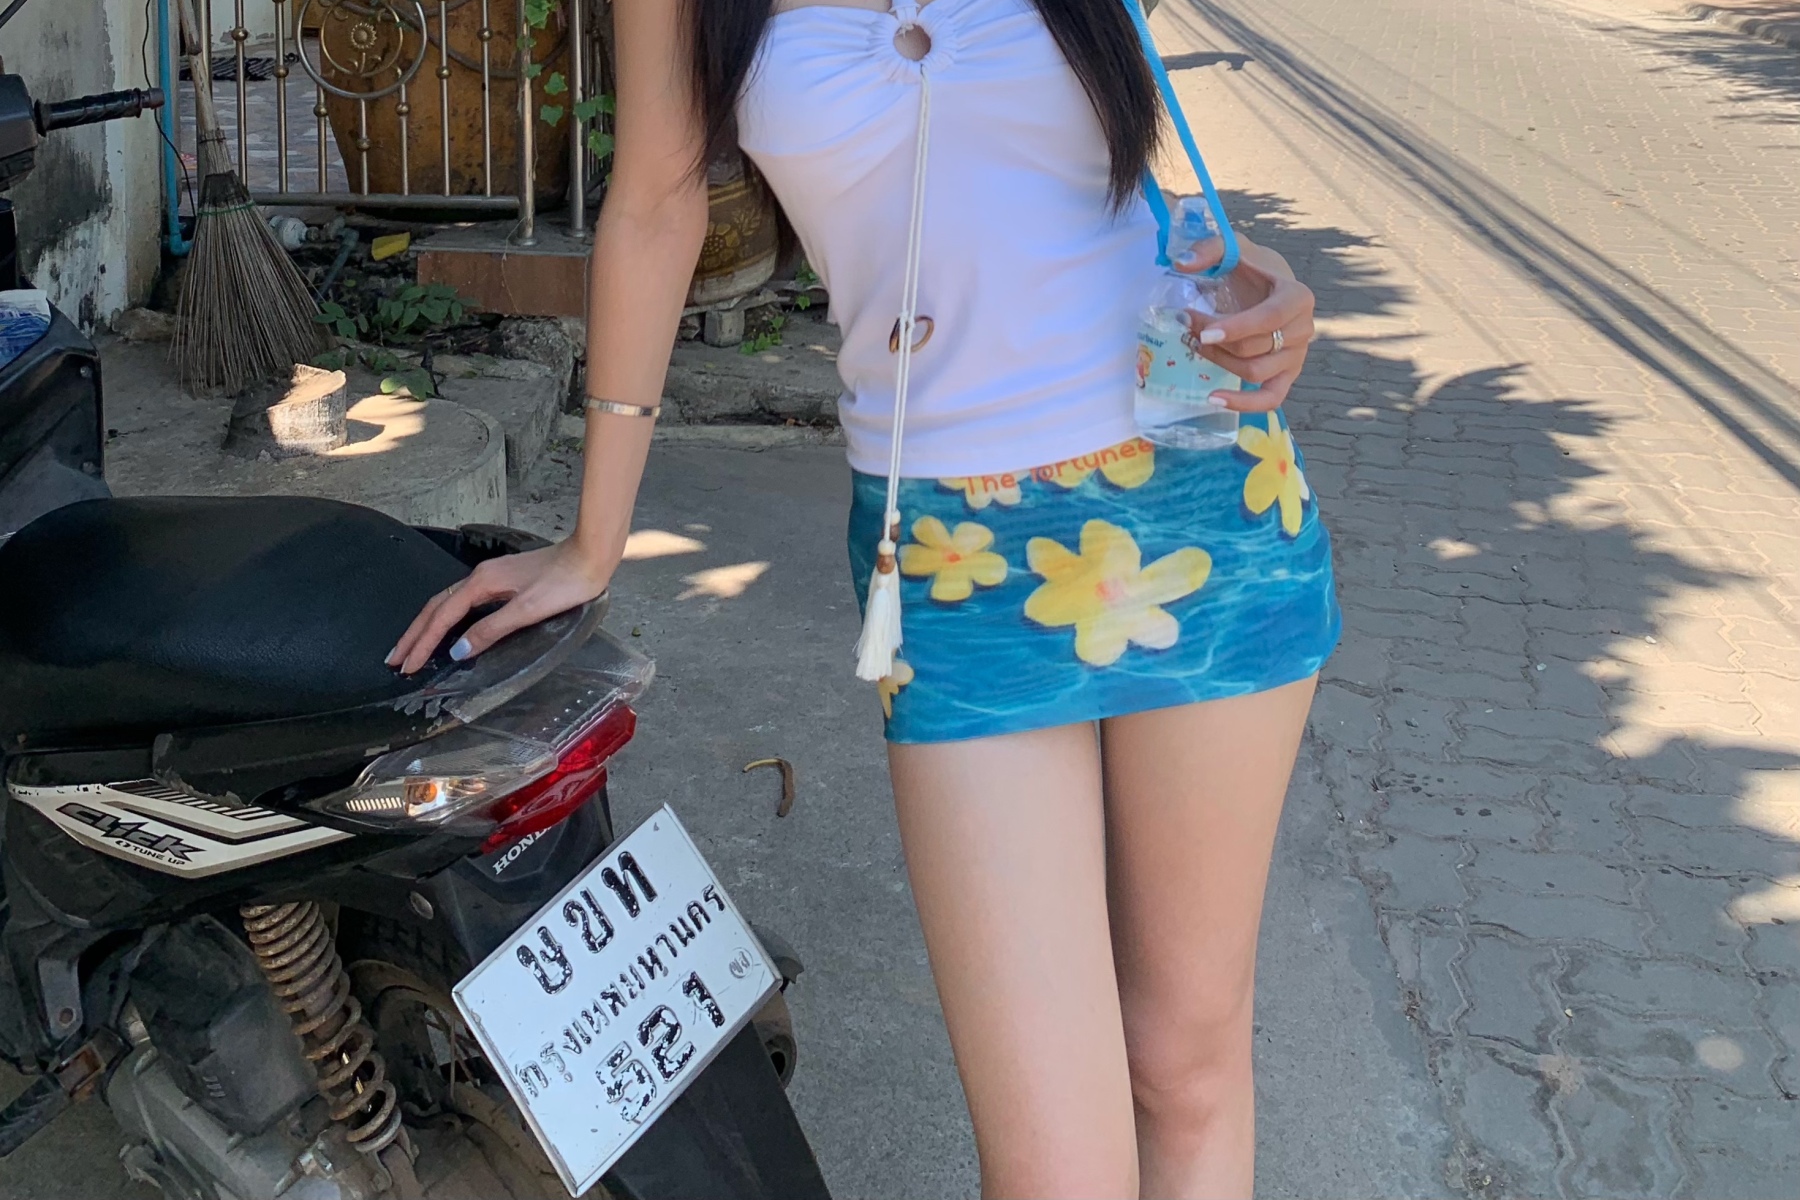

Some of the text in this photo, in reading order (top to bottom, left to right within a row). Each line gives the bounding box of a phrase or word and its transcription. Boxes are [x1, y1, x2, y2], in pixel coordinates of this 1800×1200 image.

[960, 472, 1017, 495] The
[133, 846, 186, 865] TUNE UP
[597, 971, 727, 1123] 521
